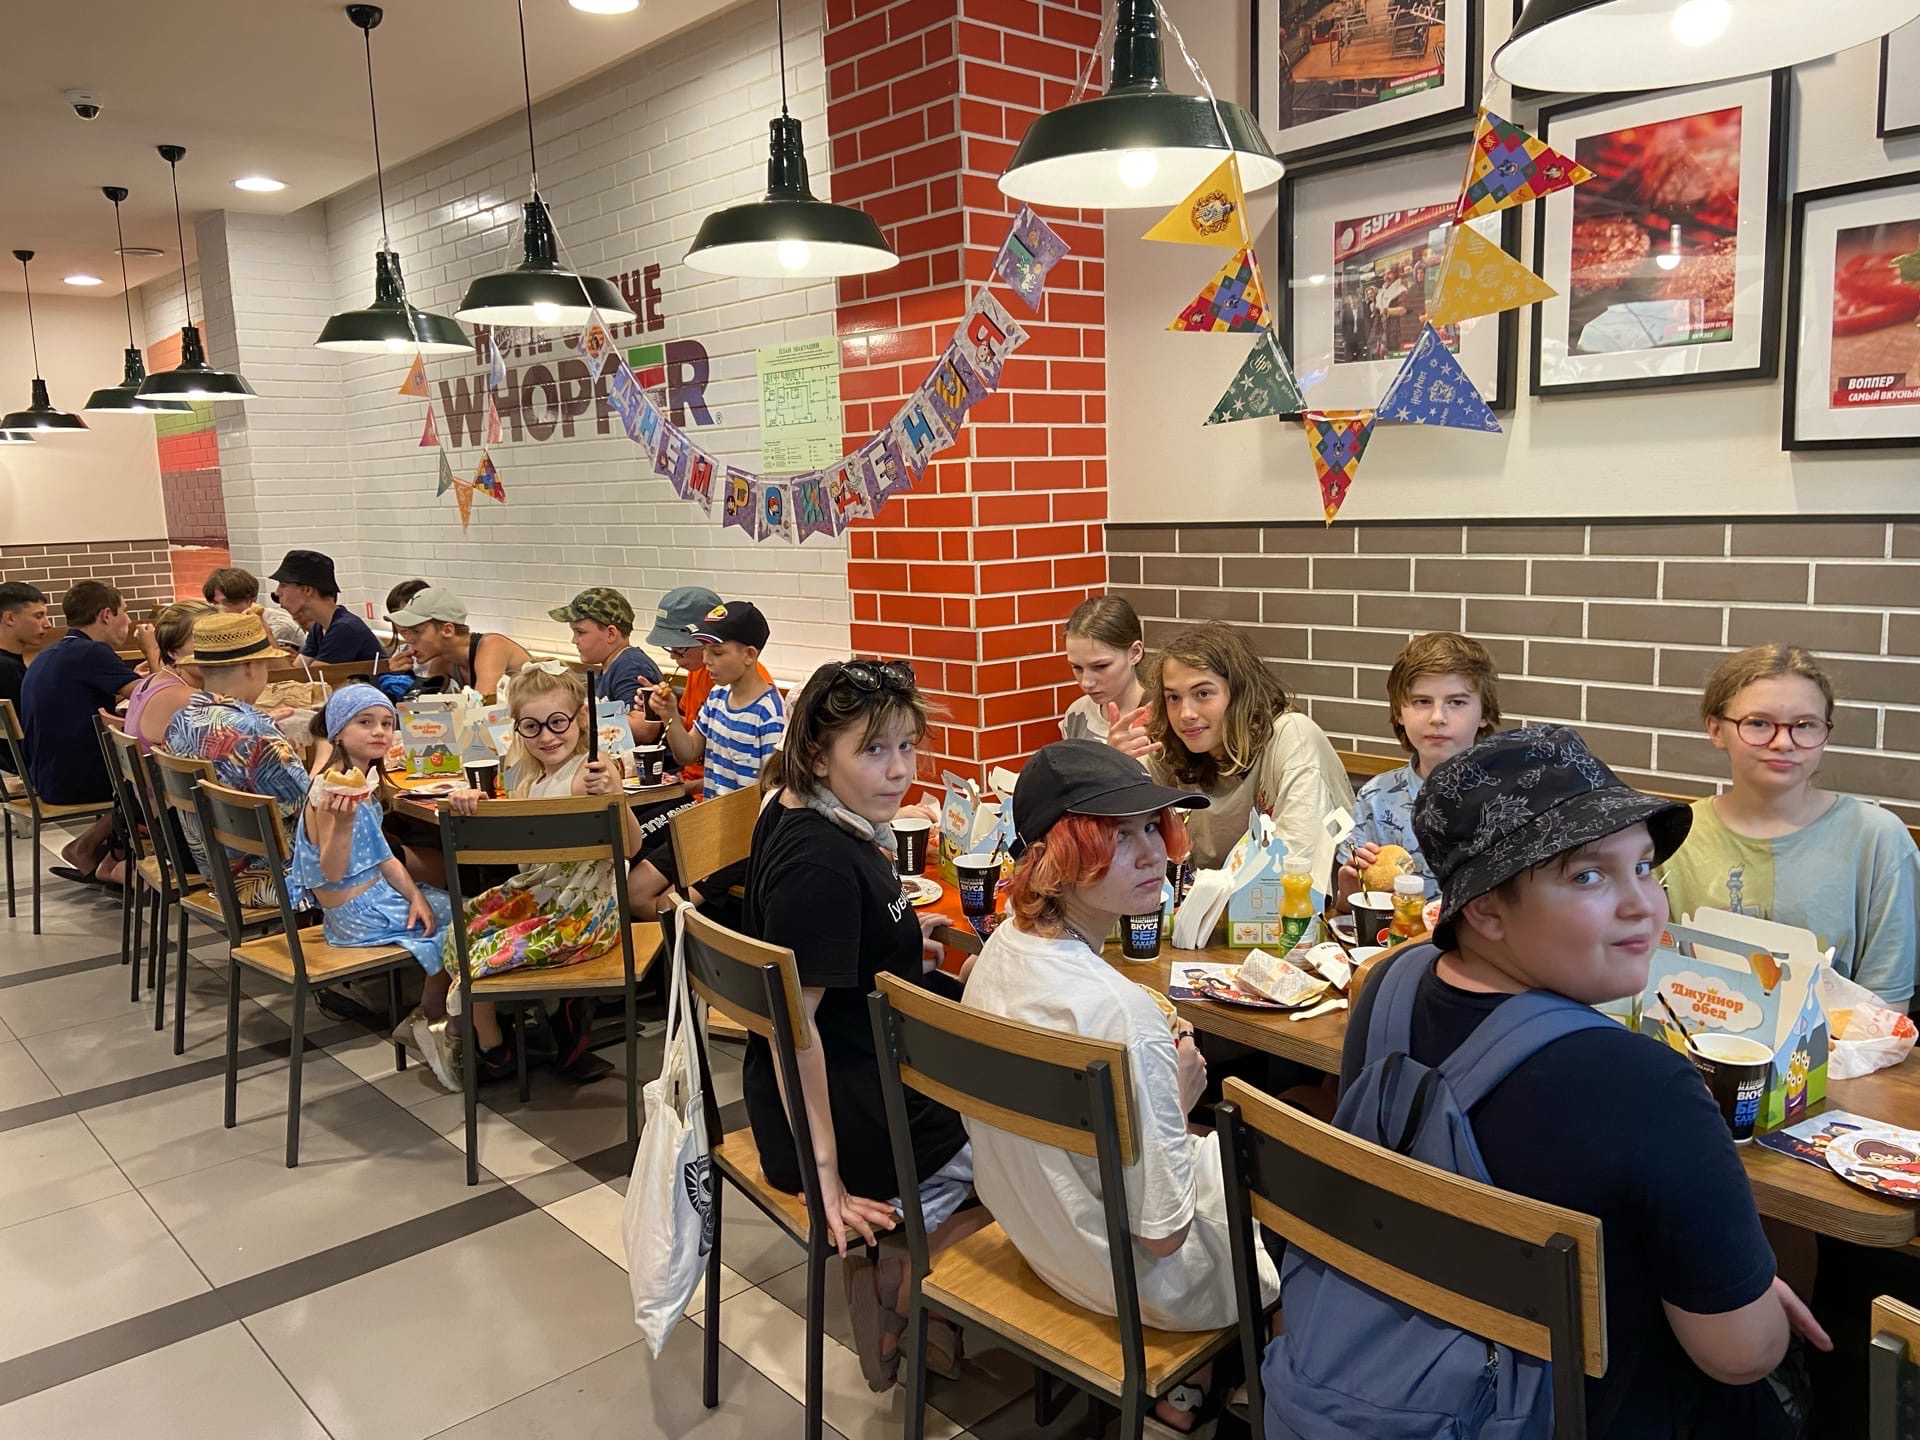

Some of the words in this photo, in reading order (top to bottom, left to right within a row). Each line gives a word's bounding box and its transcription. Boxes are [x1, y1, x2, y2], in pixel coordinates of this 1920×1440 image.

[608, 263, 665, 338] HE
[1848, 375, 1895, 390] ВОППЕР
[1848, 390, 1880, 402] САМЫЙ
[962, 891, 984, 901] БЕЗ
[1130, 922, 1158, 930] ВКУСА
[1131, 930, 1158, 940] БЕЗ
[1671, 982, 1744, 1014] Джуниор
[1692, 1001, 1727, 1021] обед
[1735, 1099, 1761, 1114] БЕ
